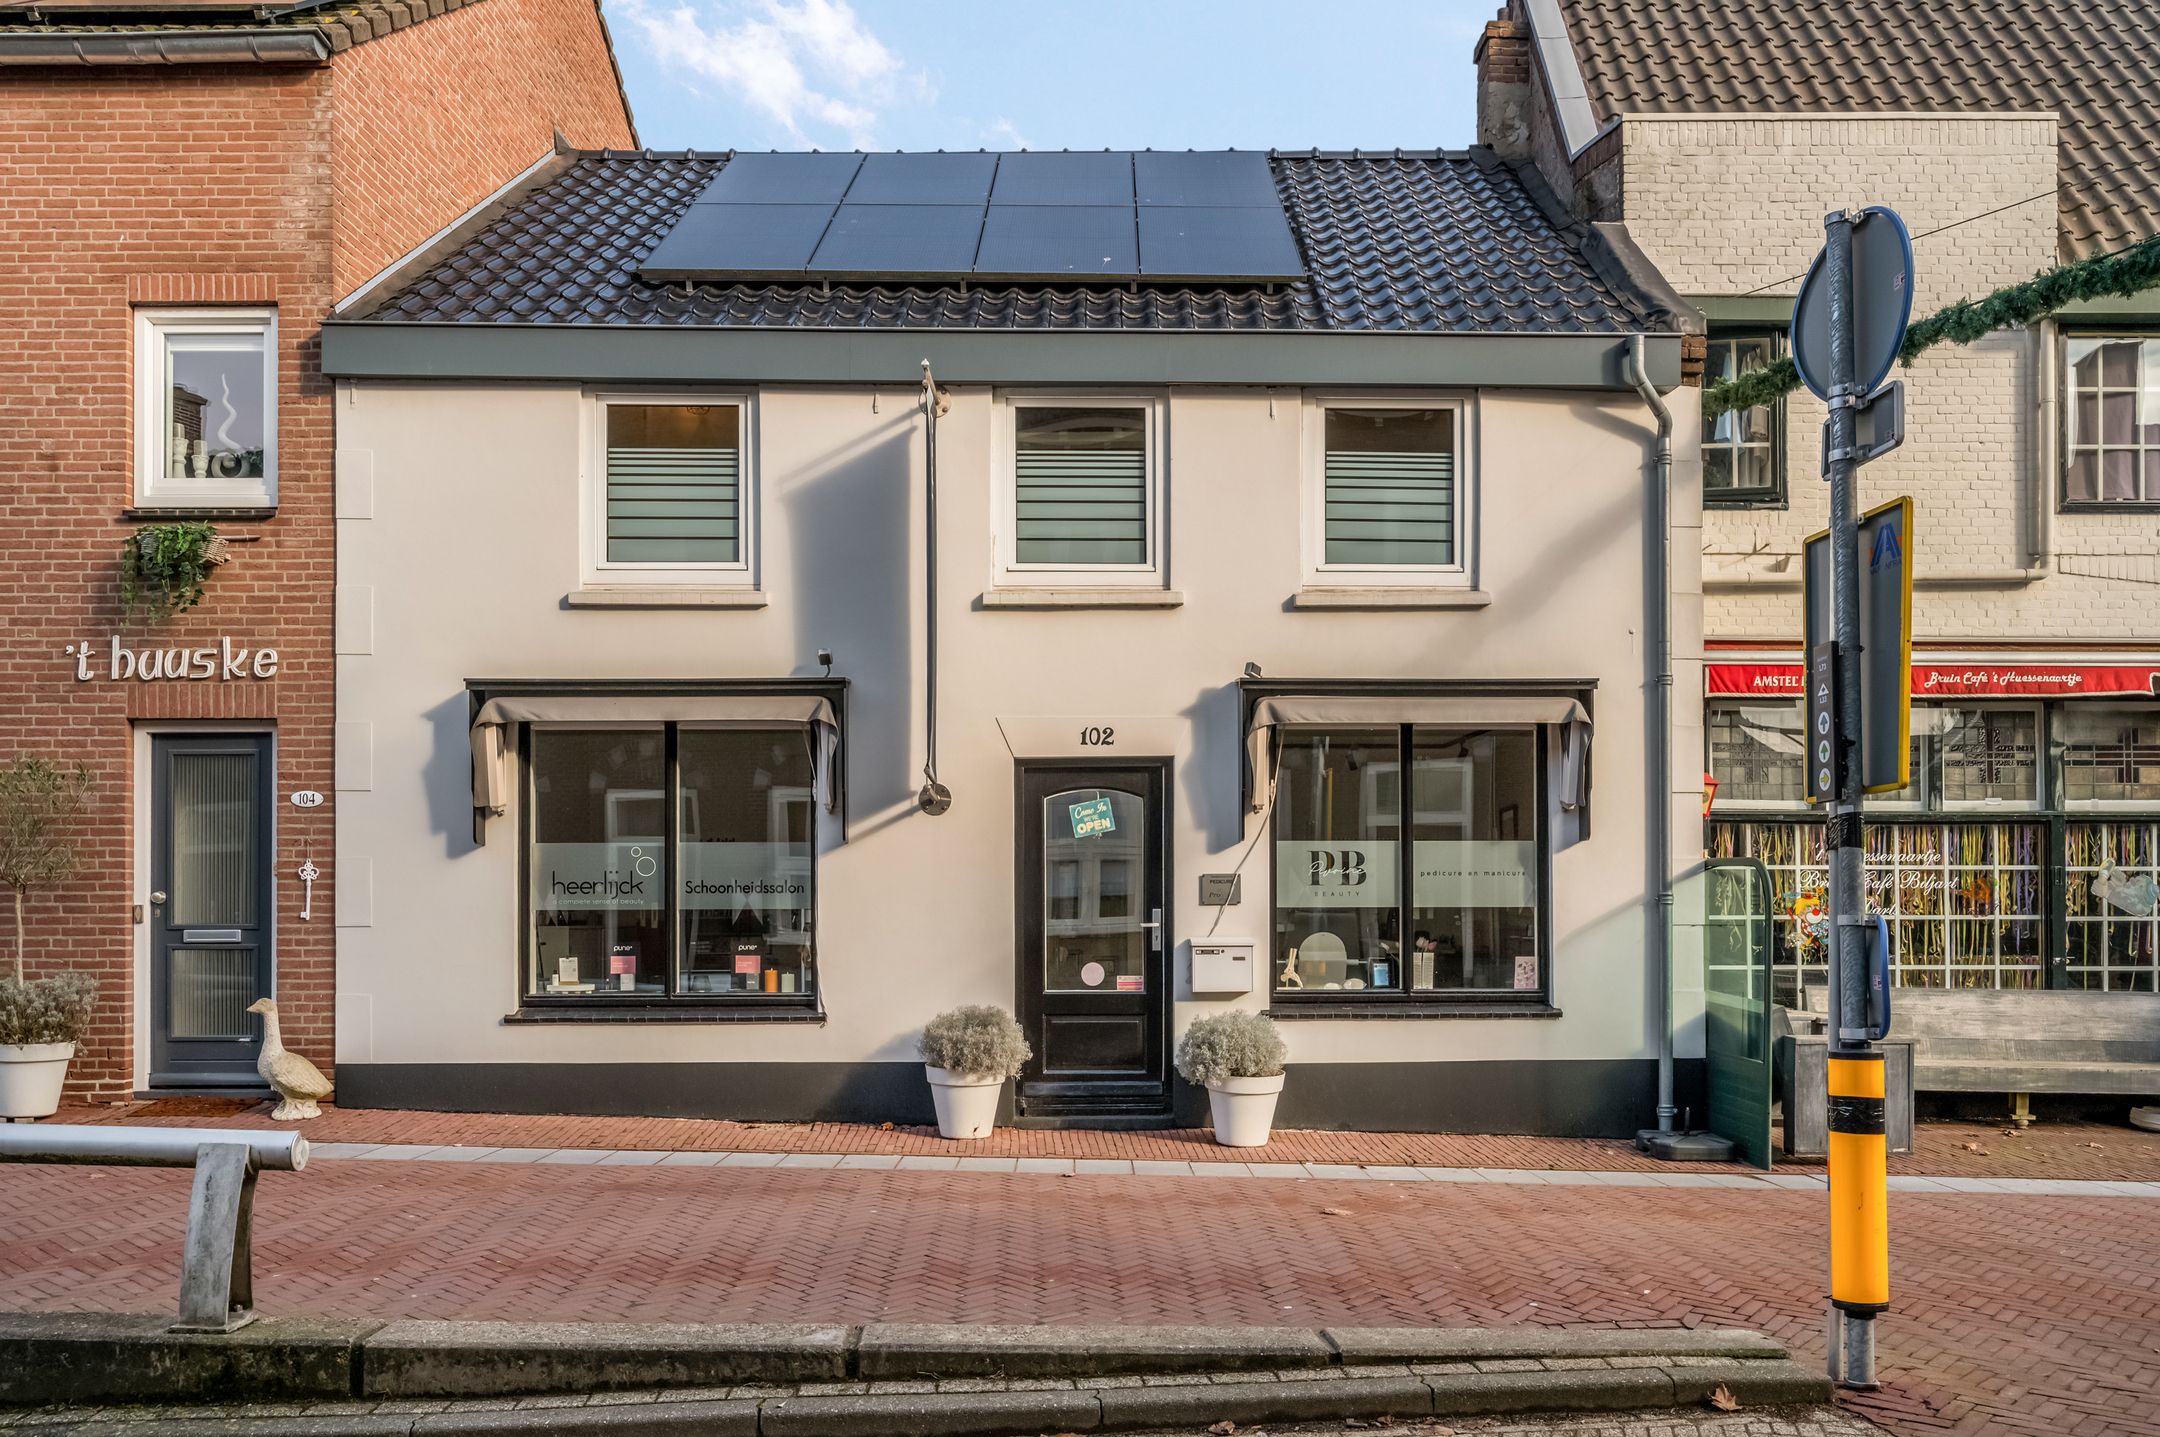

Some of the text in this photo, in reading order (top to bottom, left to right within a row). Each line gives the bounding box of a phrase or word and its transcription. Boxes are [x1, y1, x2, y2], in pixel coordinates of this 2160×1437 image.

[111, 635, 278, 681] huuske
[1753, 676, 1799, 687] AMSTEL
[1924, 671, 1960, 688] Bruin
[1963, 671, 1988, 687] Café
[1999, 671, 2082, 687] Huessenaartje
[1080, 727, 1115, 745] 102
[298, 793, 316, 805] 104
[1076, 817, 1111, 833] OPEN
[1864, 848, 1942, 867] essenaartje
[1307, 850, 1367, 886] PB
[1420, 870, 1463, 878] pedicure
[552, 870, 644, 899] heerlijck
[685, 879, 805, 895] Schoonheidssalon
